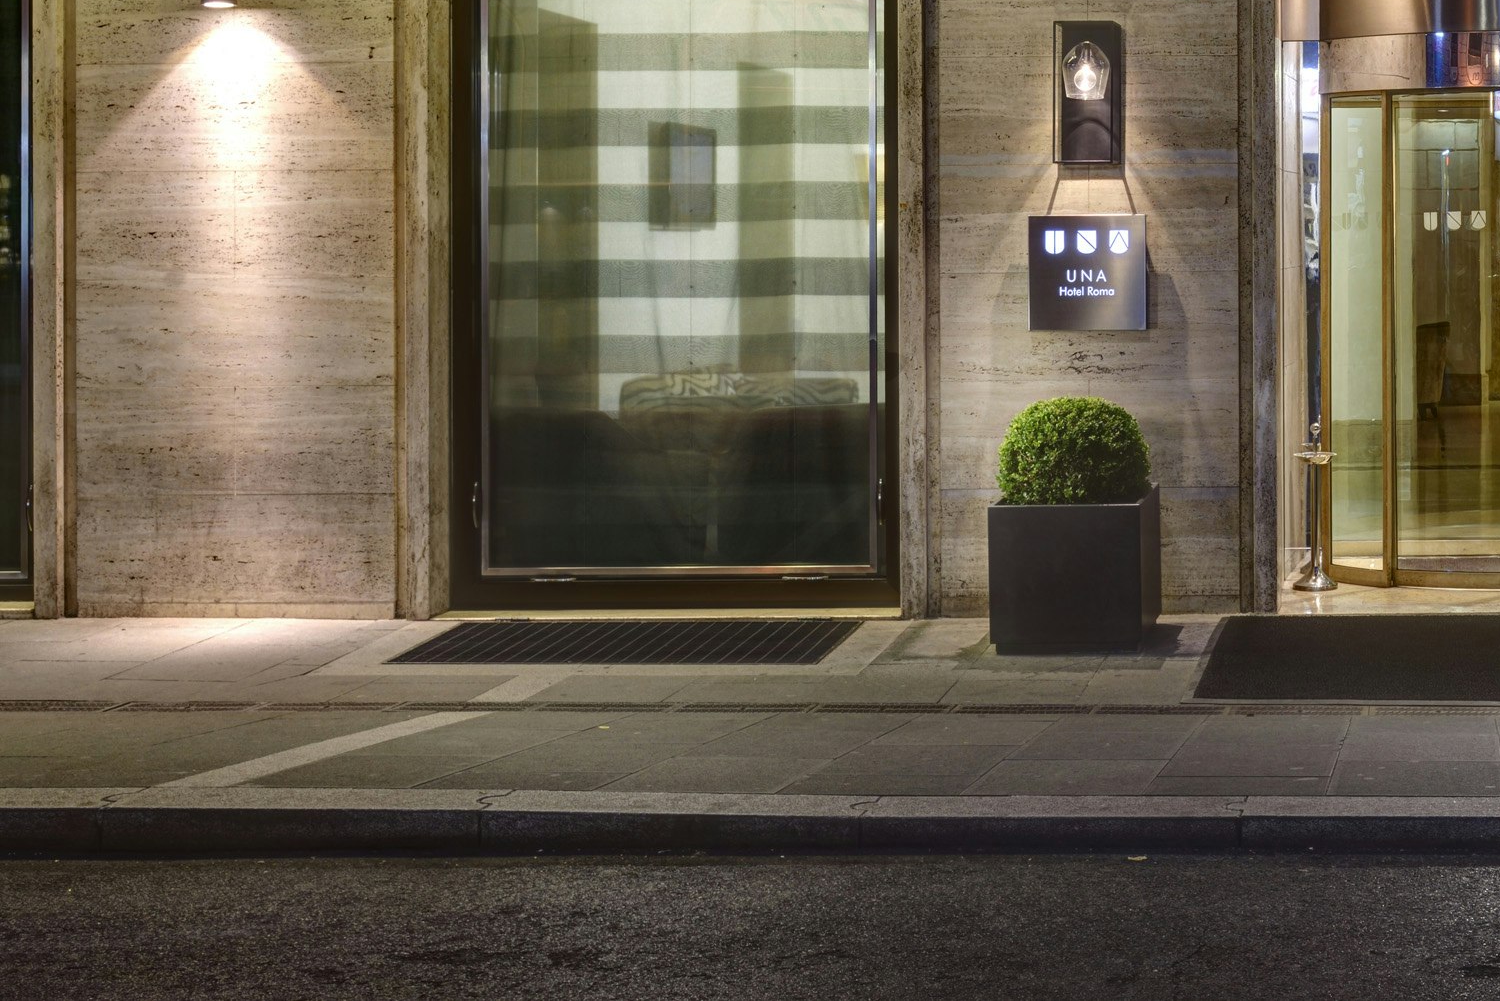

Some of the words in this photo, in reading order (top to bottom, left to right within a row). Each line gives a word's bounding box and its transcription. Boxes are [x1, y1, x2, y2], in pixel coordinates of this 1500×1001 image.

[1066, 269, 1107, 283] UNA
[1059, 286, 1085, 297] Hotel
[1087, 286, 1115, 297] Roma
